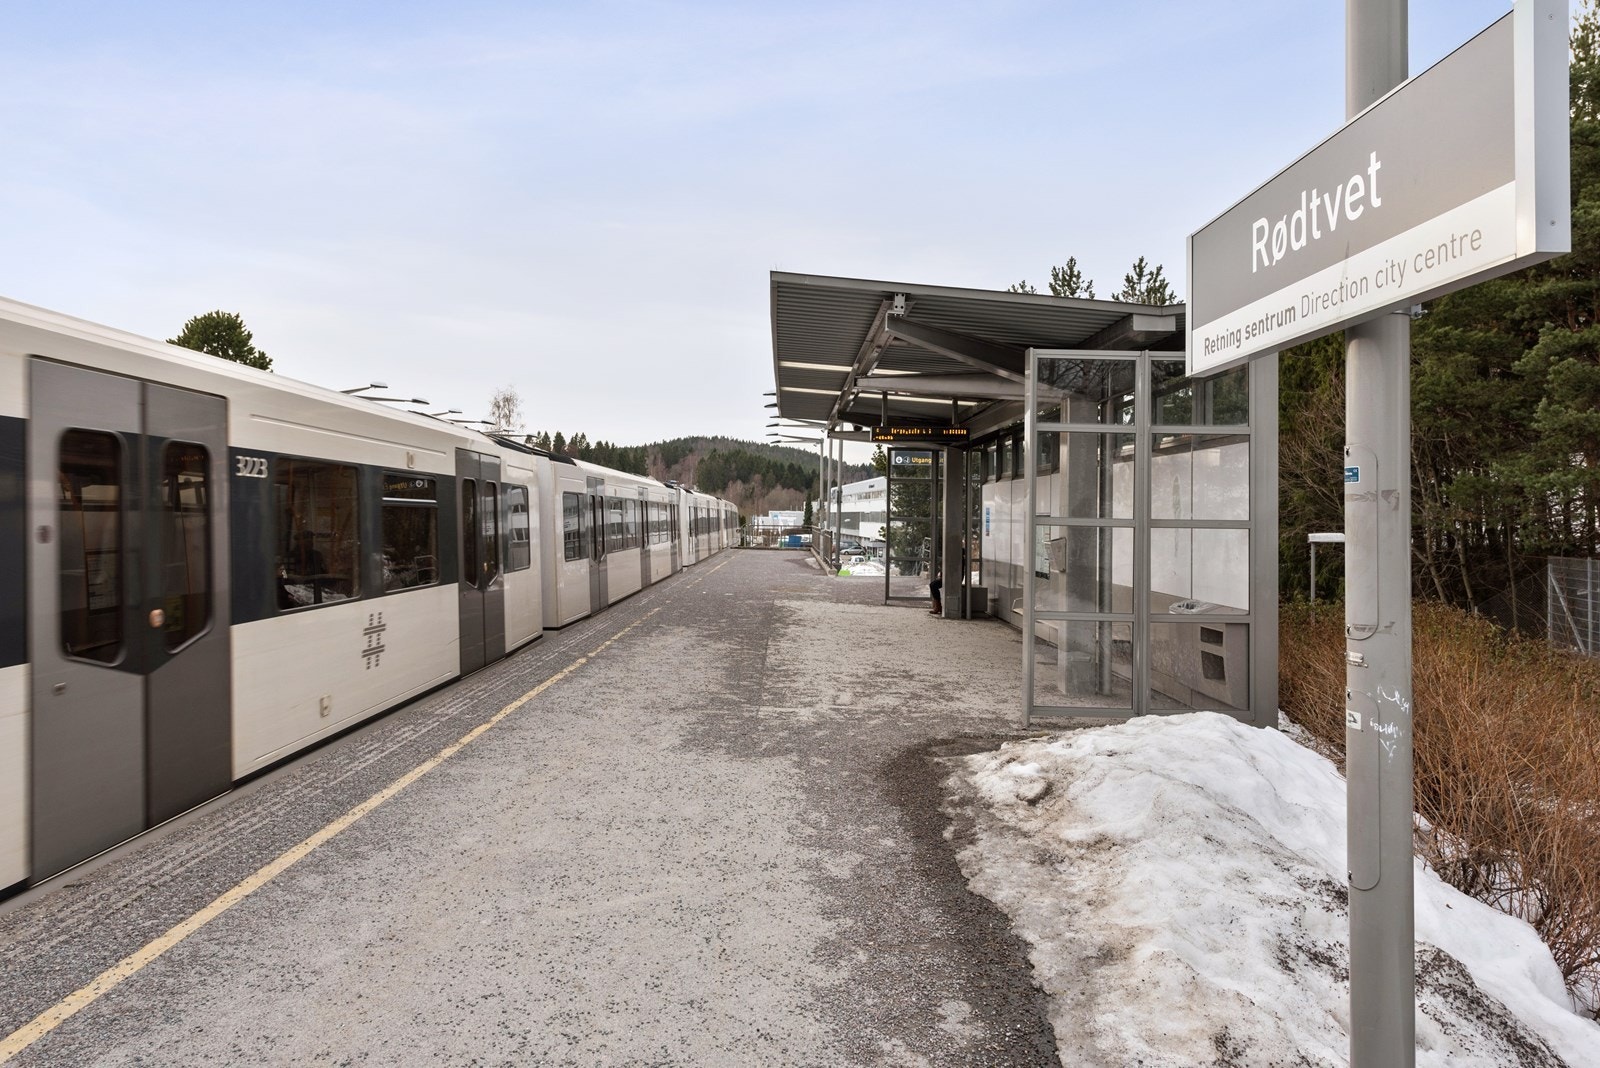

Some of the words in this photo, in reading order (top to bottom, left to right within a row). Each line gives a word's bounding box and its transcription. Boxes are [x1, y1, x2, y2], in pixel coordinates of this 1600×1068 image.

[1252, 151, 1381, 273] Rødtvet
[1204, 328, 1241, 356] Retning
[1245, 305, 1296, 340] sentrum
[1301, 276, 1369, 318] Direction
[1375, 259, 1407, 288] city
[1414, 229, 1482, 273] centre
